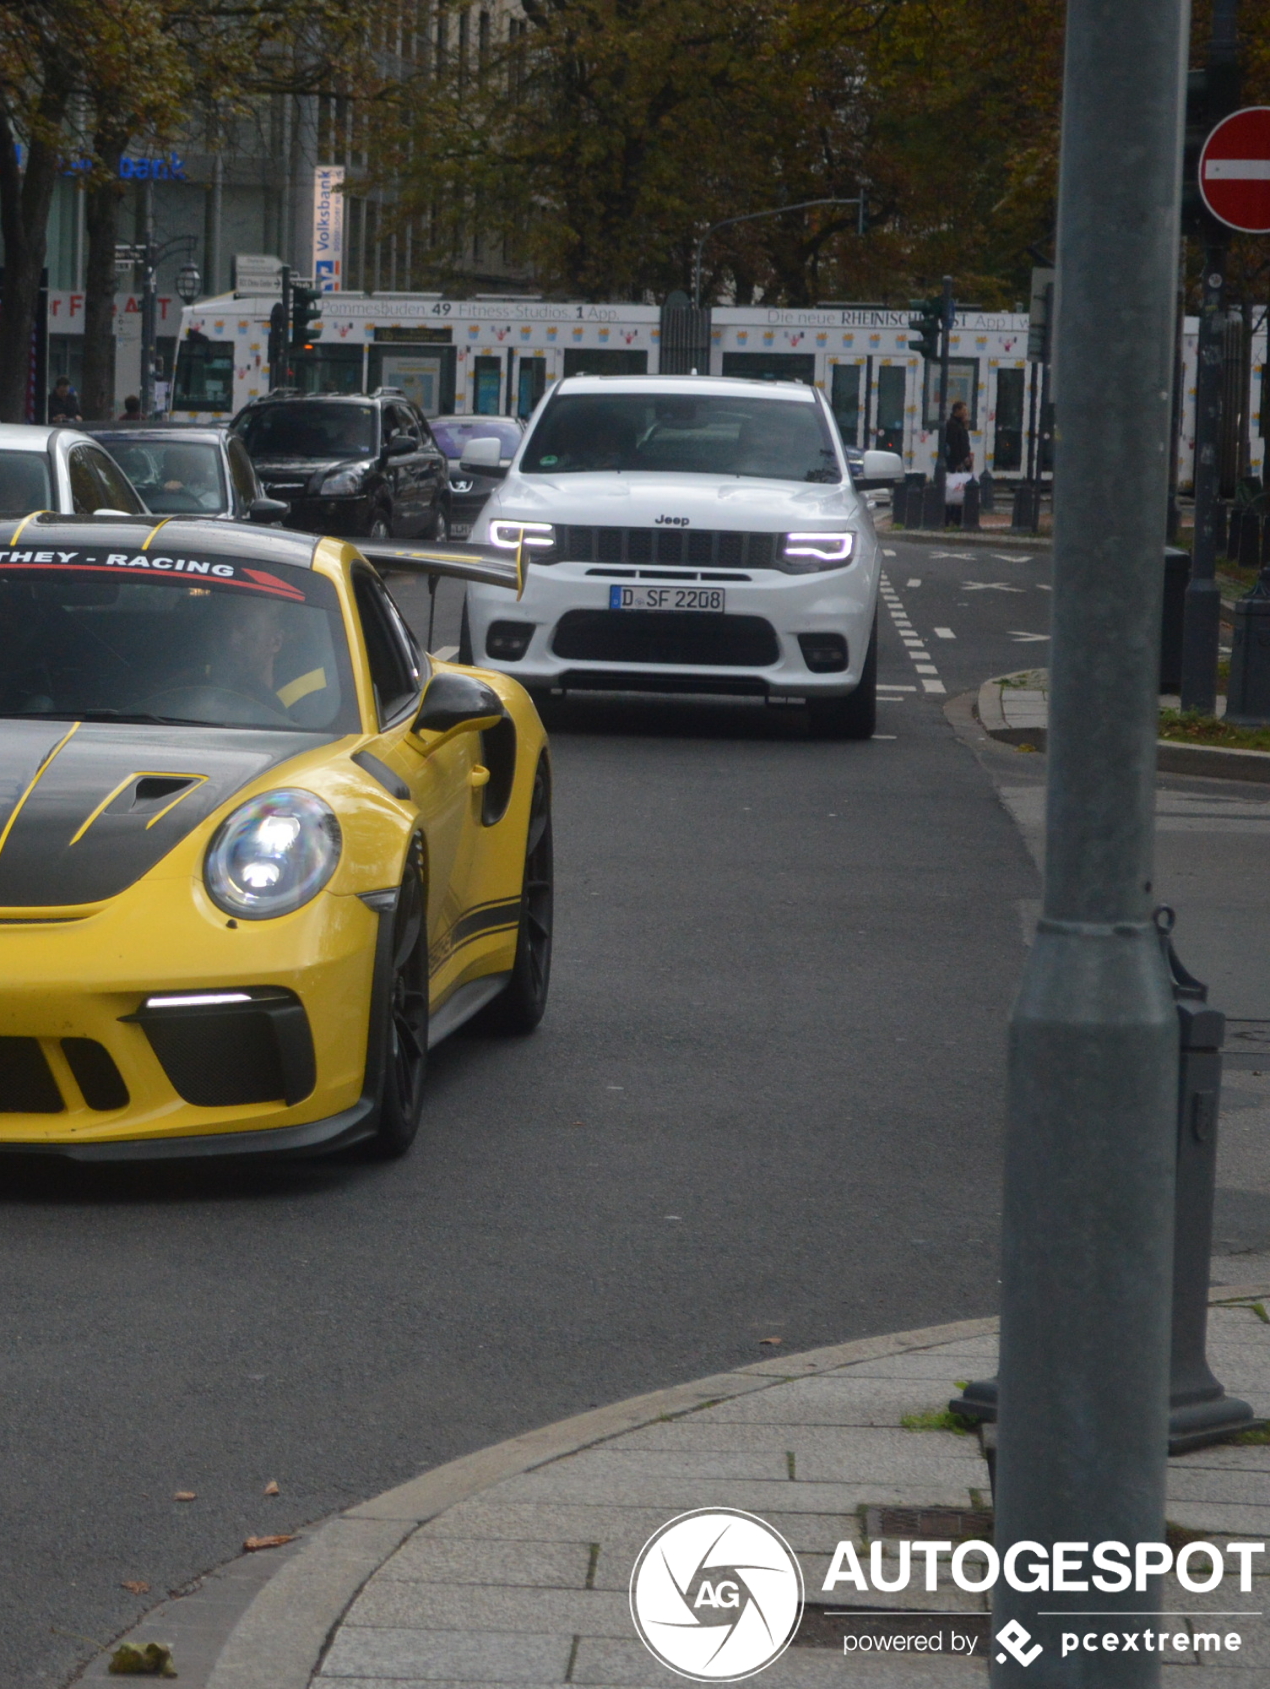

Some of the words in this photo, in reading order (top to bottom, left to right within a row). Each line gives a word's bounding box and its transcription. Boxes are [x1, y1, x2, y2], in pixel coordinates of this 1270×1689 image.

[316, 170, 331, 252] Volksbank
[431, 303, 451, 317] 49
[575, 306, 584, 319] 1
[767, 309, 793, 323] Die
[798, 313, 836, 325] neue
[975, 314, 1006, 330] App
[654, 514, 690, 527] Jeep
[105, 553, 235, 577] RACING
[622, 589, 634, 606] D
[646, 590, 670, 607] SF
[675, 591, 721, 609] 2208
